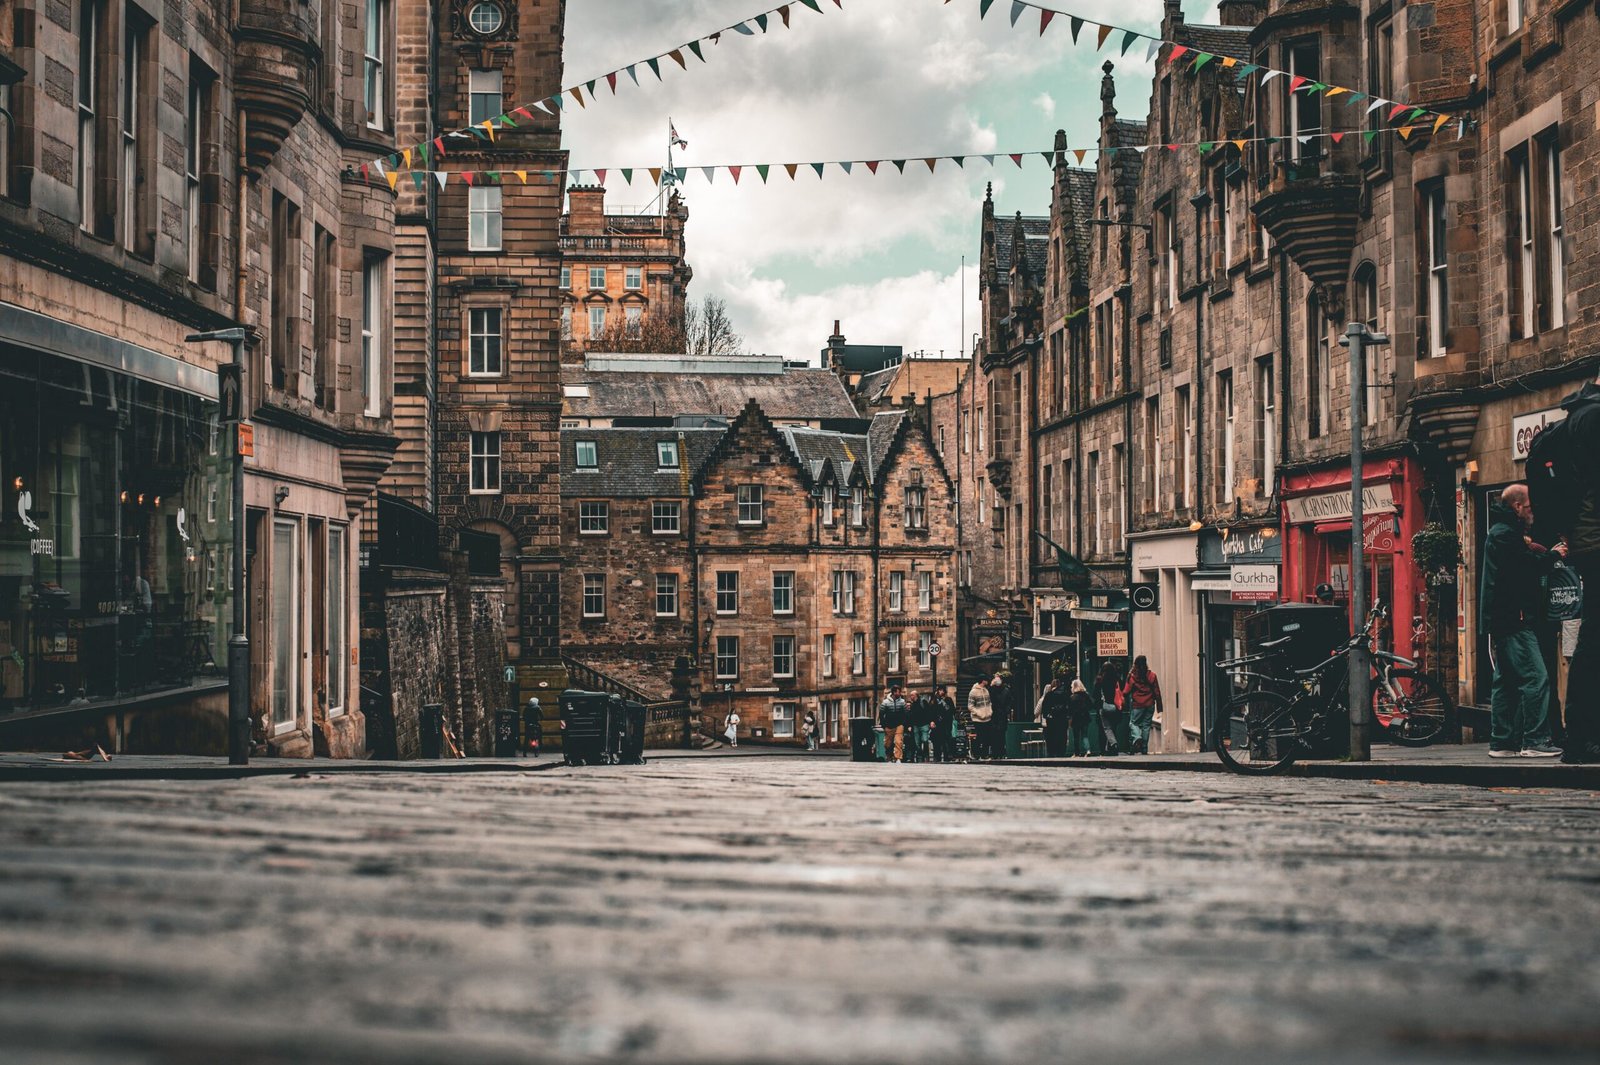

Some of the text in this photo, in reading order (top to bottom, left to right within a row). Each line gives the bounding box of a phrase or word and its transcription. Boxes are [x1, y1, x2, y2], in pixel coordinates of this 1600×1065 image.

[31, 538, 53, 556] (COFFEE)
[1221, 533, 1245, 562] Gurkha
[1234, 572, 1276, 584] Gurkha
